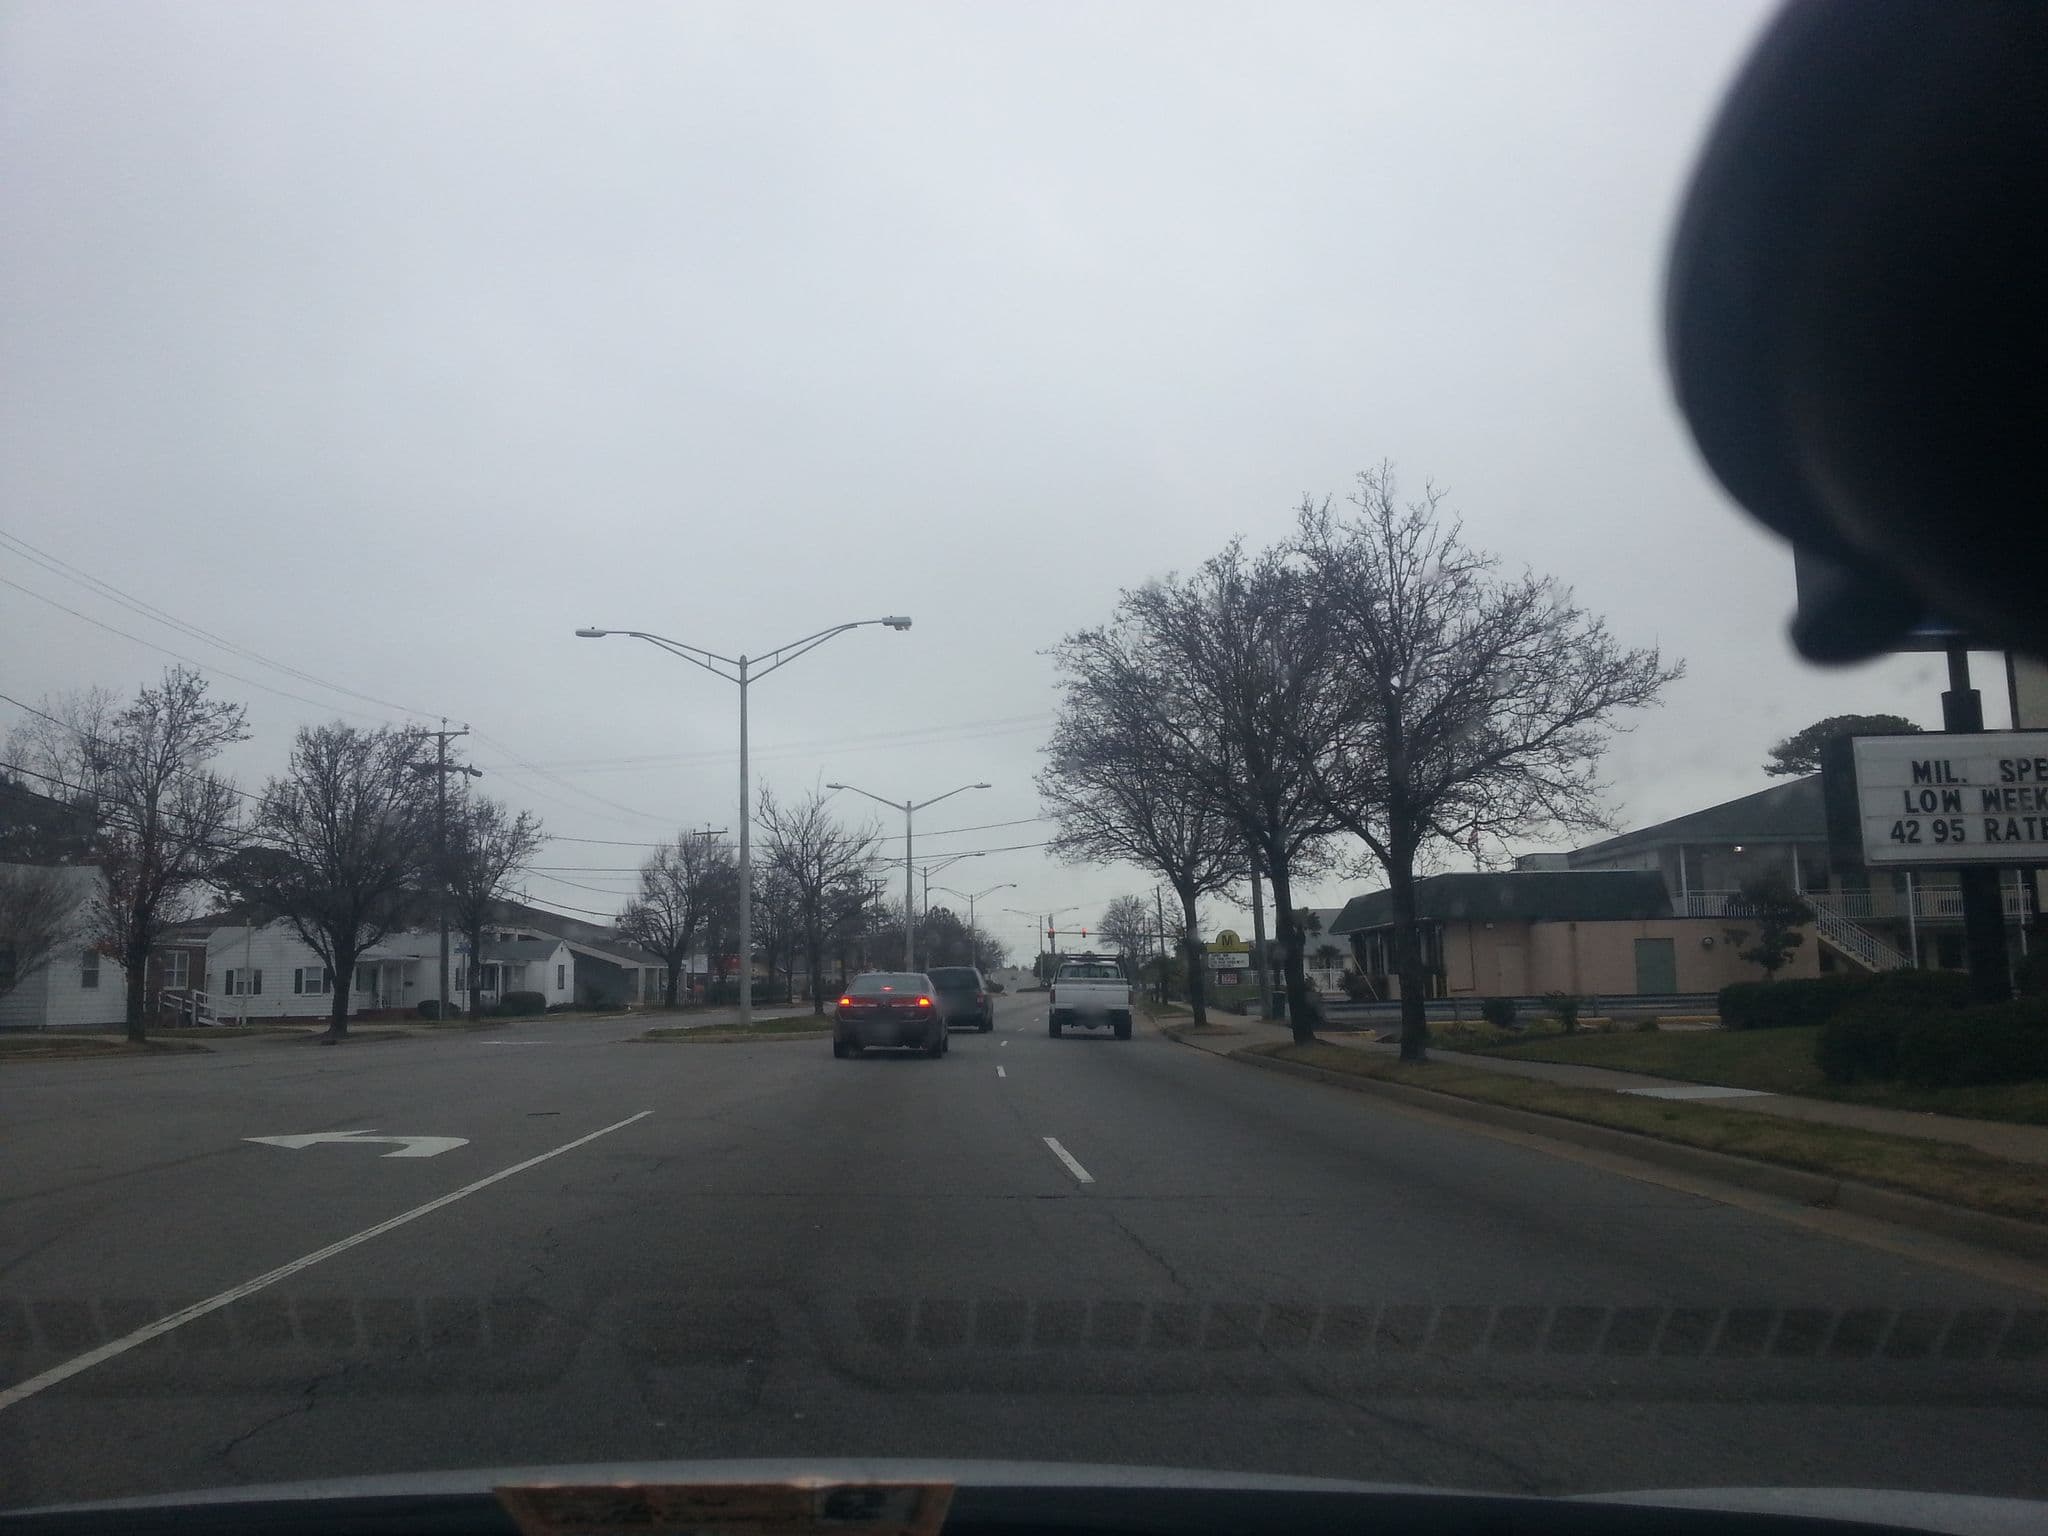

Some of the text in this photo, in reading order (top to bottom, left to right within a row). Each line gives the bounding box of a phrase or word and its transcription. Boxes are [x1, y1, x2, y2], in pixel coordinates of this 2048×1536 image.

[1912, 757, 2048, 784] MIL. SPE
[1904, 789, 1962, 813] LOW
[1890, 819, 1922, 844] 42
[1932, 818, 1965, 843] 95
